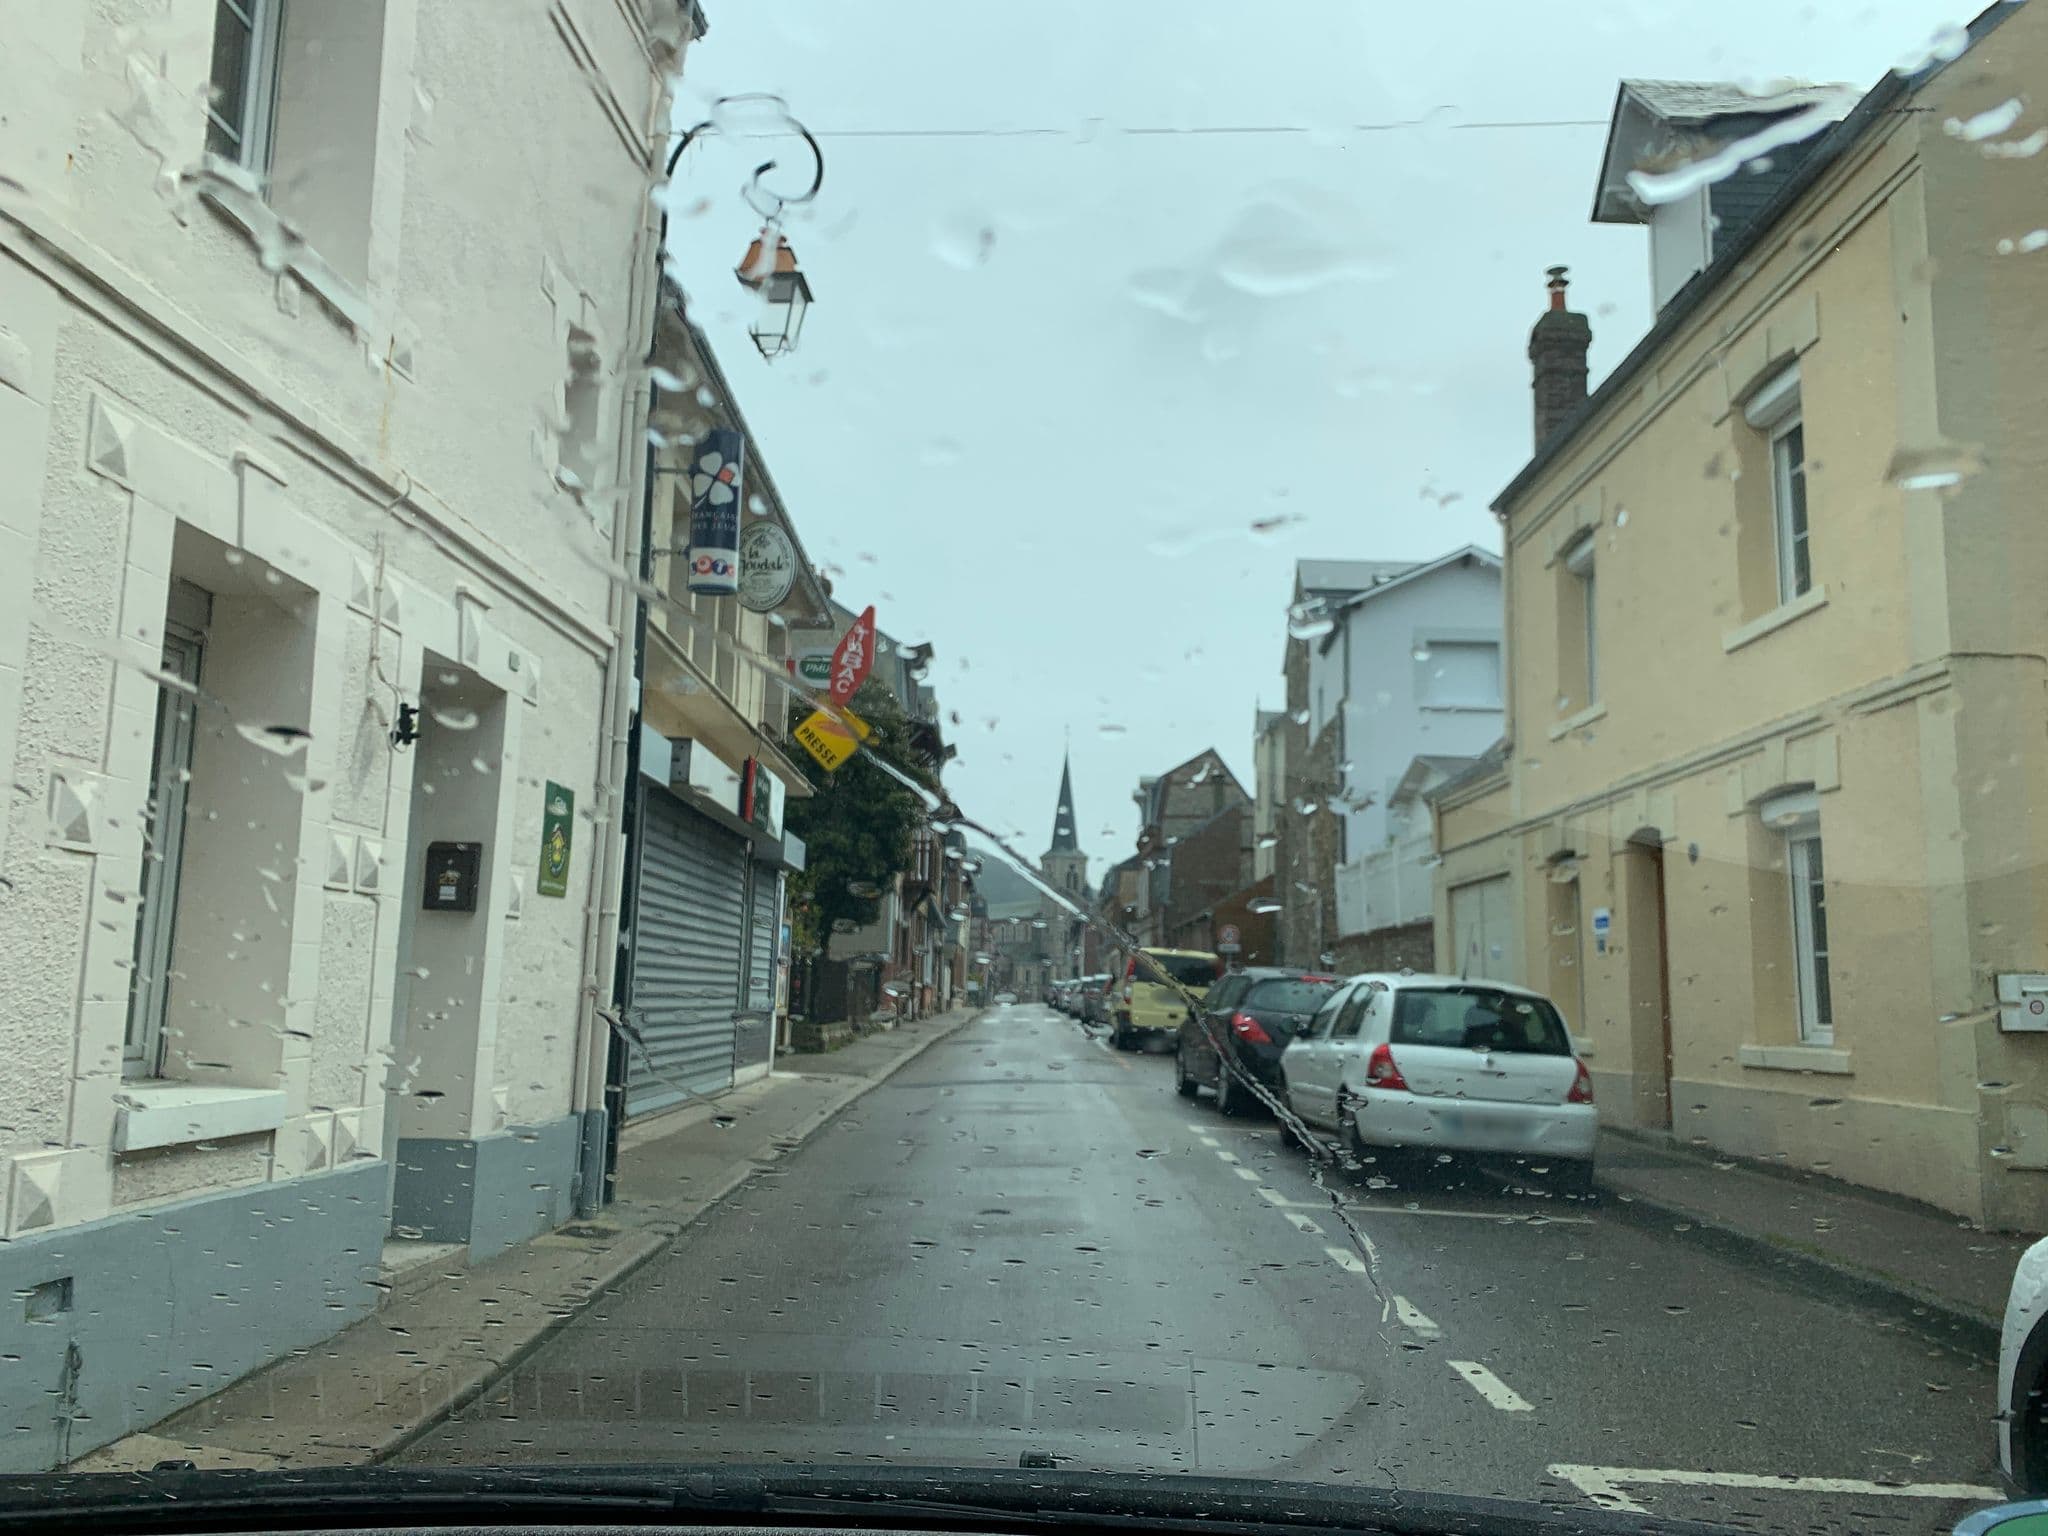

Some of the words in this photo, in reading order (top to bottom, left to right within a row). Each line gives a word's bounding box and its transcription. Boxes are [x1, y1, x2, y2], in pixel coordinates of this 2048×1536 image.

[805, 662, 831, 674] PMU
[836, 624, 869, 694] TABAC
[801, 726, 838, 766] PRESSE
